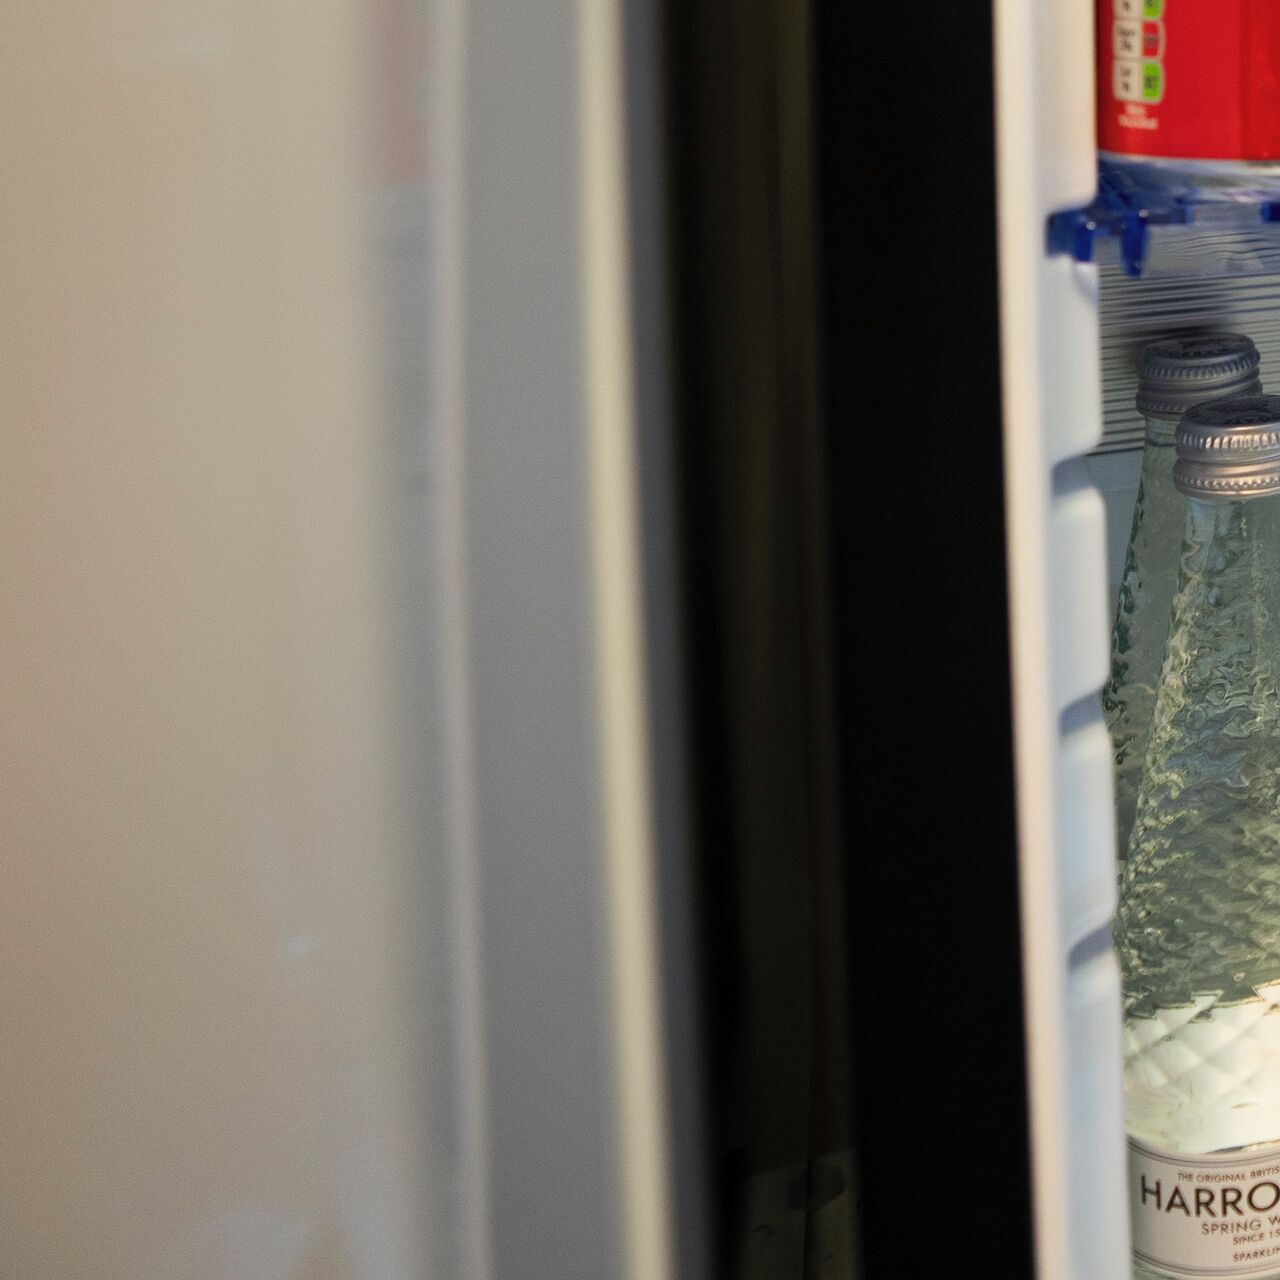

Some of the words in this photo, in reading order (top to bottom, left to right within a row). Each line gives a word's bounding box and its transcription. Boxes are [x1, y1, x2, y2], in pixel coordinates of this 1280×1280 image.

[1178, 1172, 1194, 1183] THE
[1196, 1172, 1246, 1183] ORIGINAL
[1201, 1220, 1262, 1236] SPRING
[1232, 1233, 1265, 1246] SINCE
